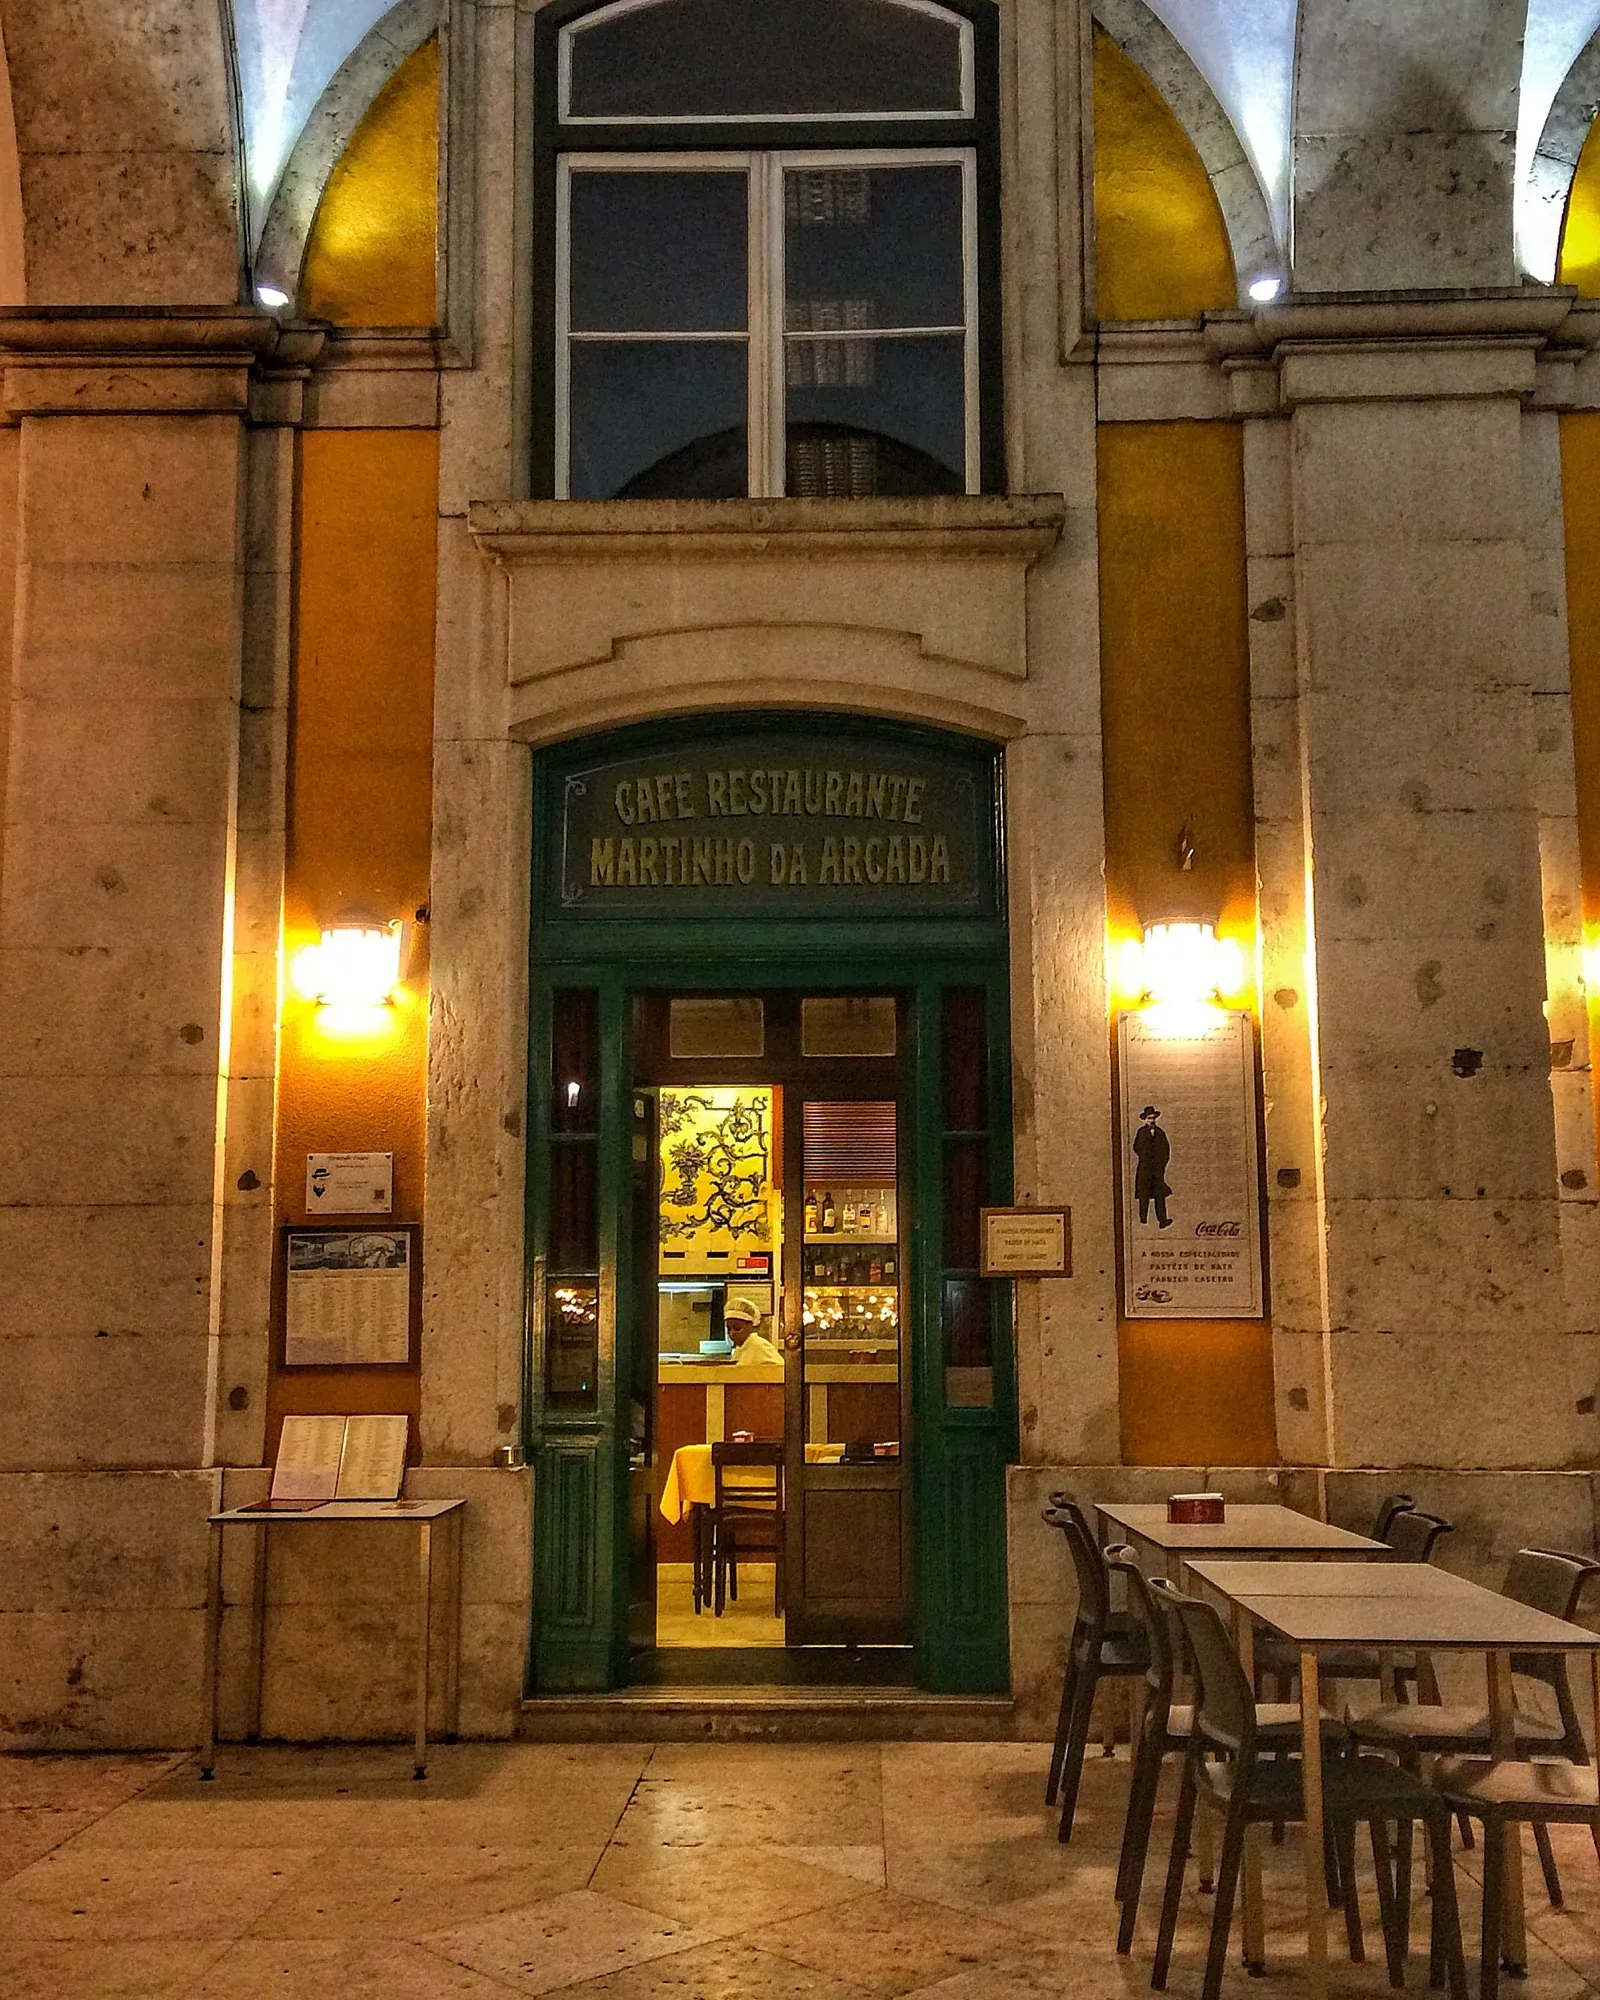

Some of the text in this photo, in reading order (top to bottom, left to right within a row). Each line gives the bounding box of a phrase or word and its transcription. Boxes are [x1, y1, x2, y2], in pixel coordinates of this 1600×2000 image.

[613, 768, 926, 825] CAFE RESTAURANTE
[589, 834, 951, 887] MARTINHO DA ARCADA
[1150, 1262, 1188, 1270] PASTÉIS
[1179, 1250, 1240, 1258] ESPECIALIDADE
